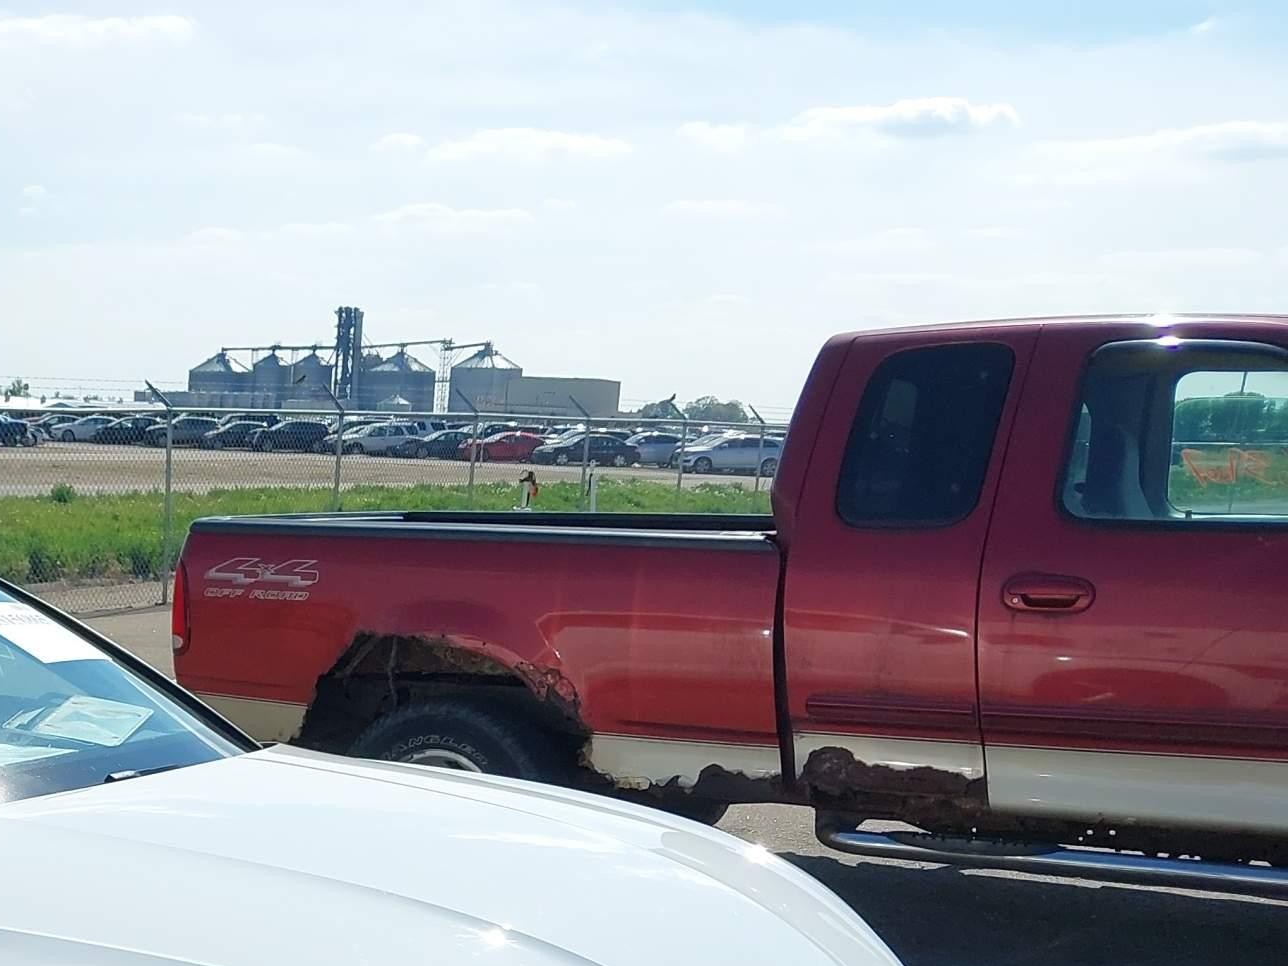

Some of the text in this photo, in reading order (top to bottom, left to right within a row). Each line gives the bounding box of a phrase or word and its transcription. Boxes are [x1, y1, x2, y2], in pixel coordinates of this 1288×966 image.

[204, 557, 319, 587] 4x4
[204, 587, 310, 601] OFF ROAD
[380, 734, 489, 765] RANGLER
